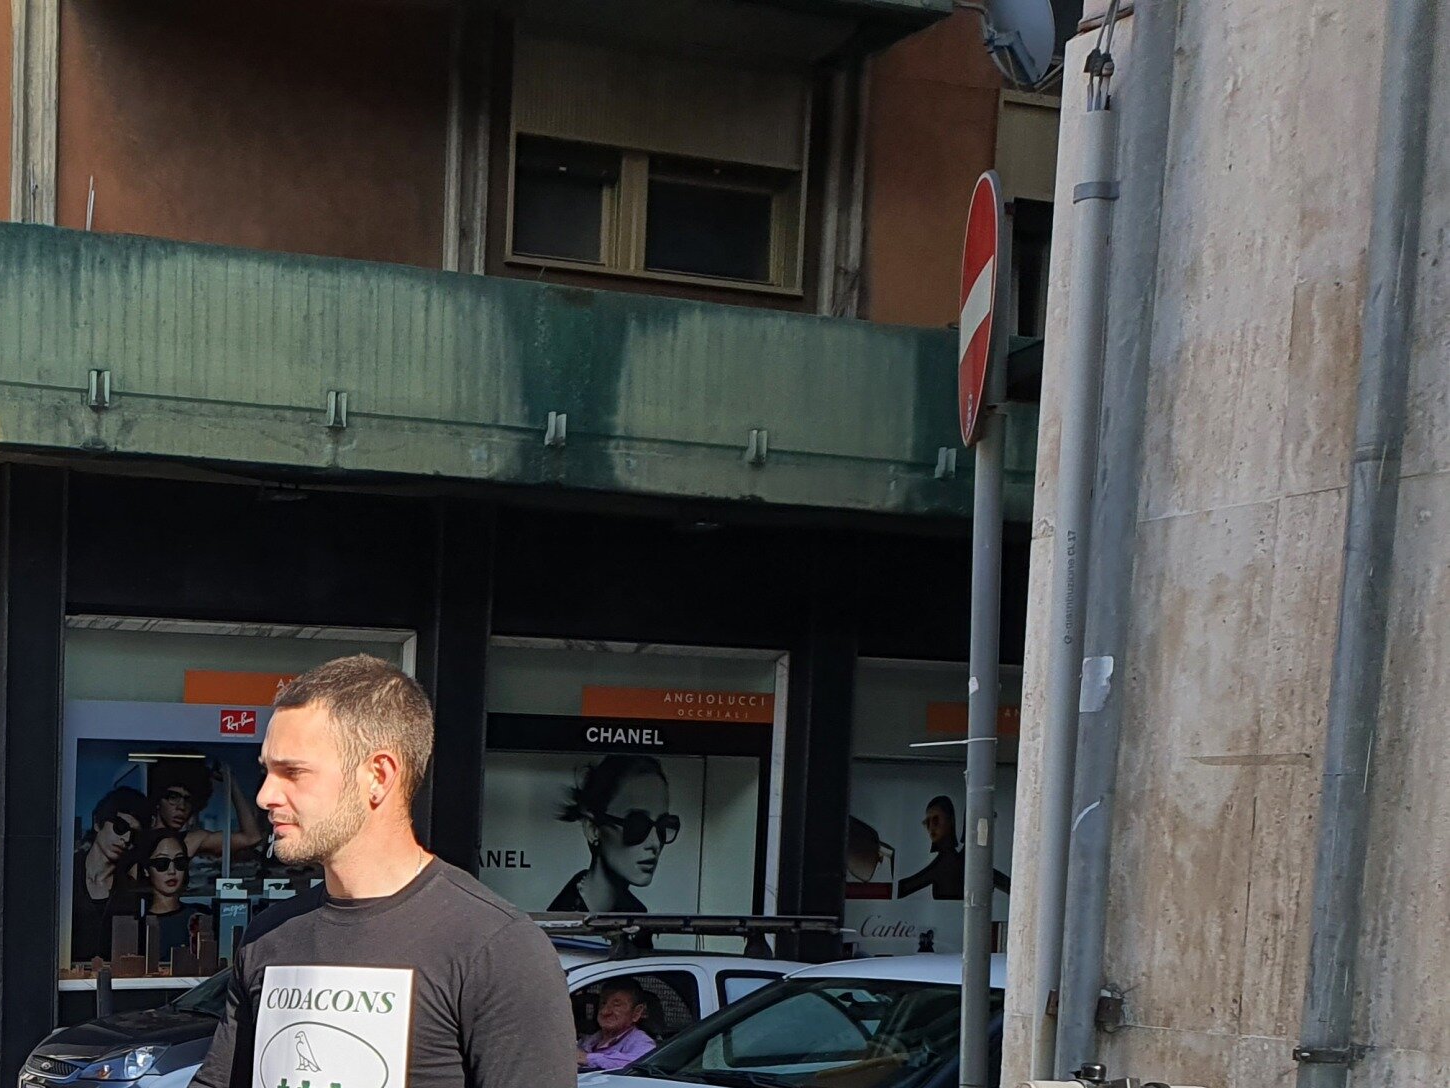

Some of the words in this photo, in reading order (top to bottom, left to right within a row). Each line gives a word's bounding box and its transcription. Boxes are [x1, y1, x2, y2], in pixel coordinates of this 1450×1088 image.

[664, 692, 765, 707] ANGIOLUCCI
[678, 709, 748, 719] OCCHIALI
[586, 727, 664, 745] CHANEL
[267, 987, 396, 1014] CODACONS
